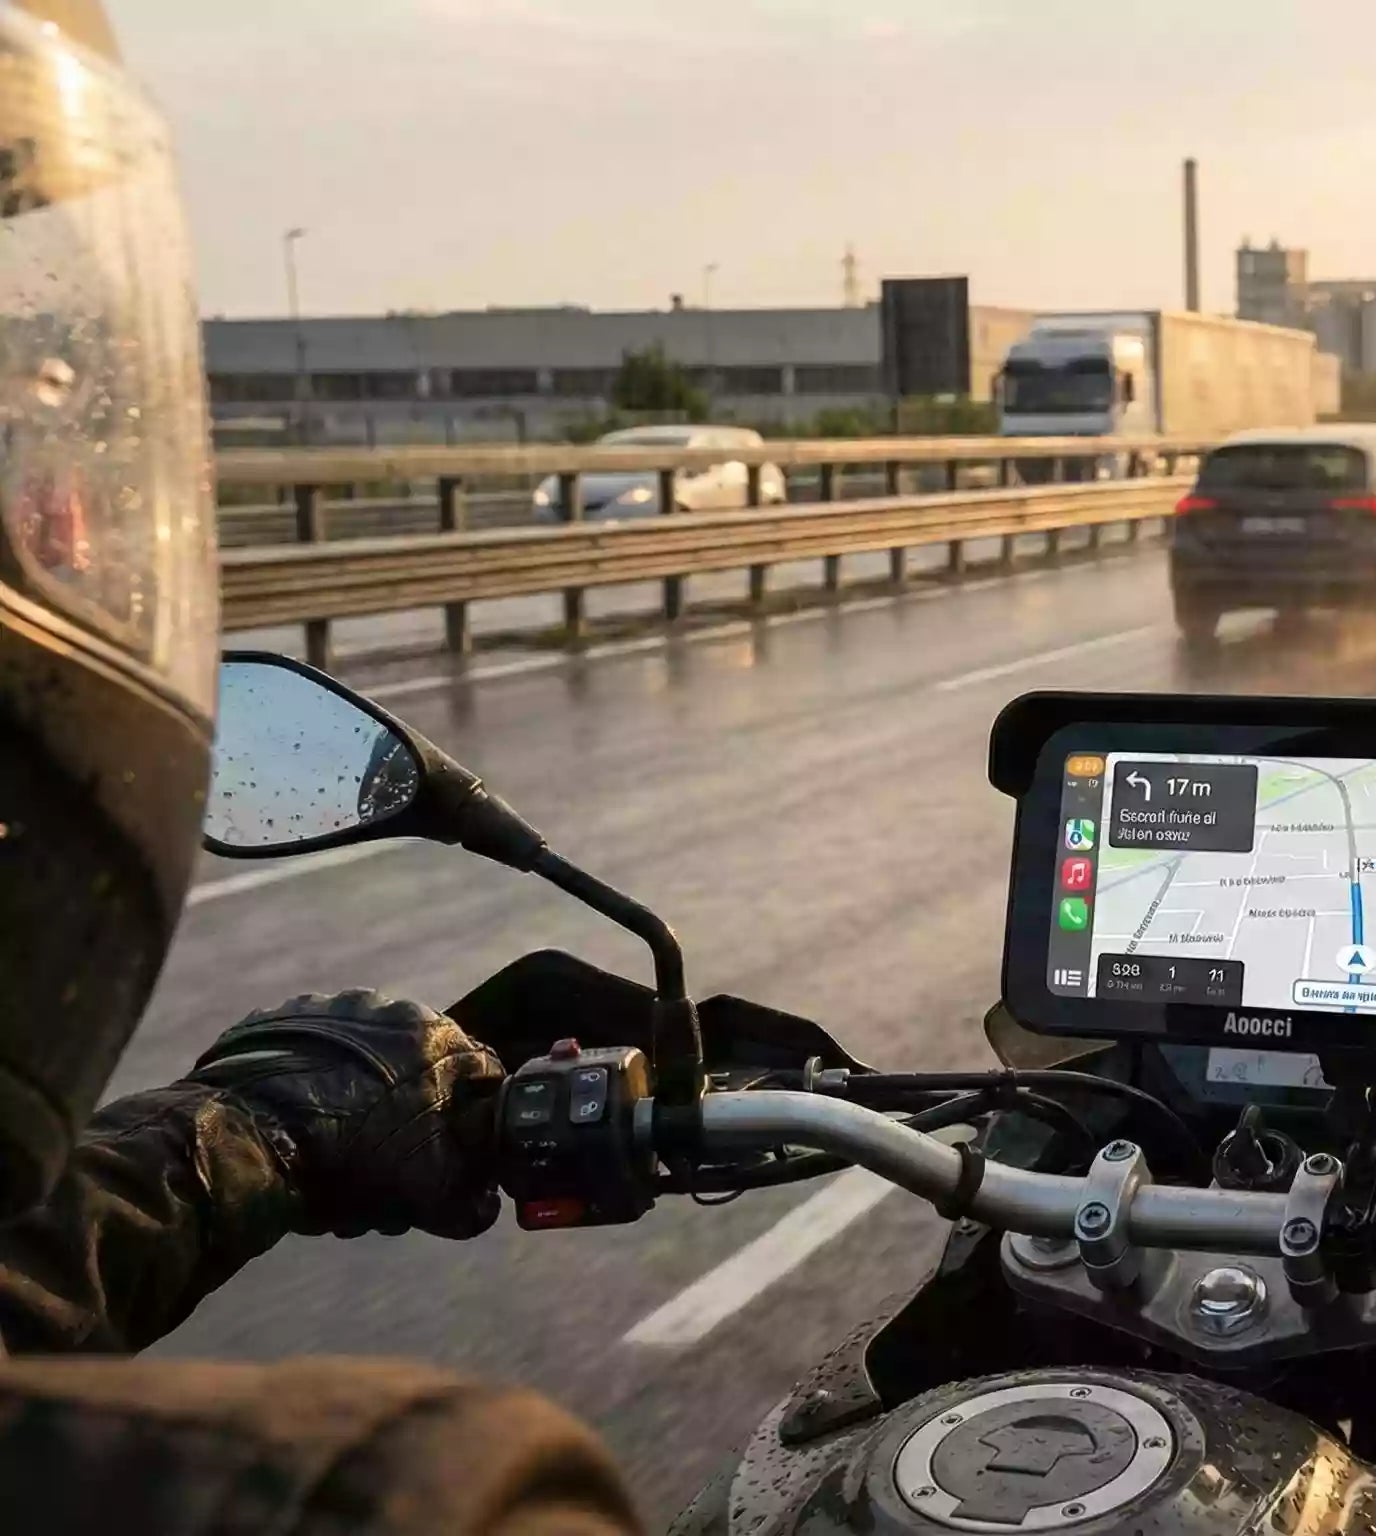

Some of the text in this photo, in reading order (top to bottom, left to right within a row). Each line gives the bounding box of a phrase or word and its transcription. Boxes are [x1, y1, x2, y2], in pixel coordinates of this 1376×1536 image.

[1166, 778, 1211, 797] 17 m
[1223, 1012, 1293, 1037] Aoocci
